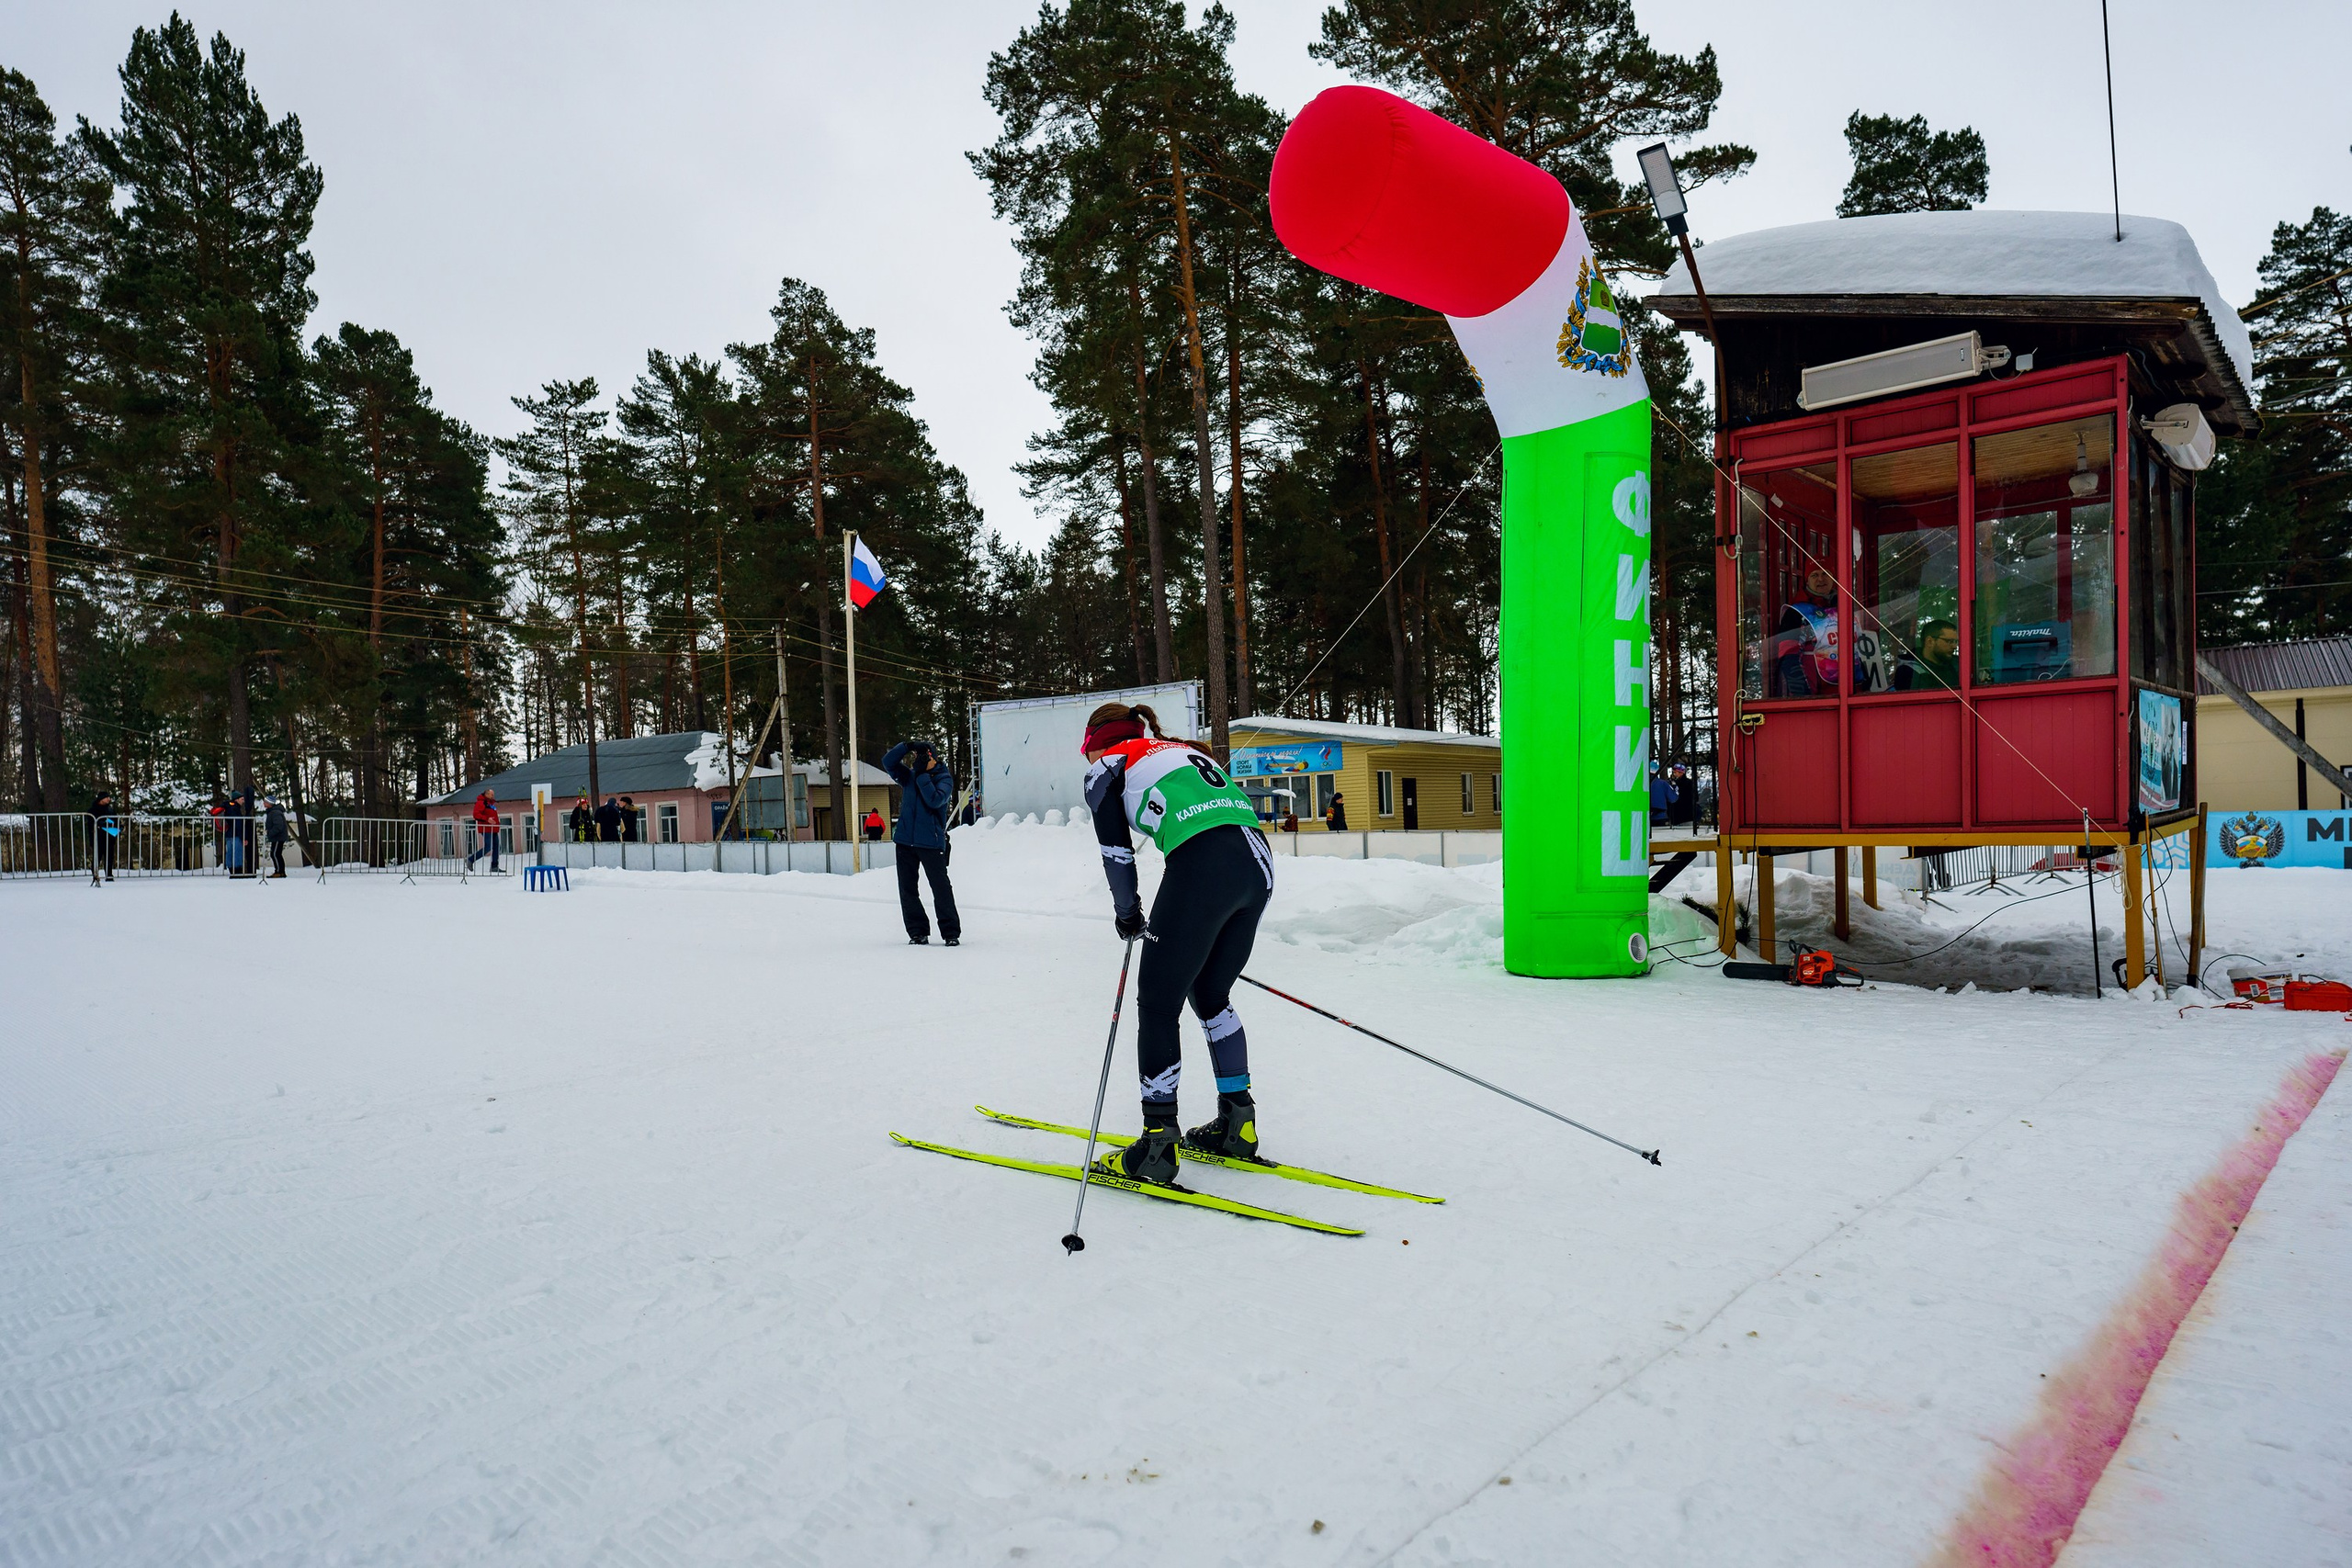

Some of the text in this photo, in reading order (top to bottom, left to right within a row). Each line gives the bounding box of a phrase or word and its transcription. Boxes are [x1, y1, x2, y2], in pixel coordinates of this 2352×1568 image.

[1187, 754, 1227, 788] 8
[1148, 800, 1164, 816] 8
[1175, 797, 1235, 822] КАЛУЖСКОЙ
[2307, 818, 2352, 841] М
[1088, 1173, 1141, 1191] FISCHER
